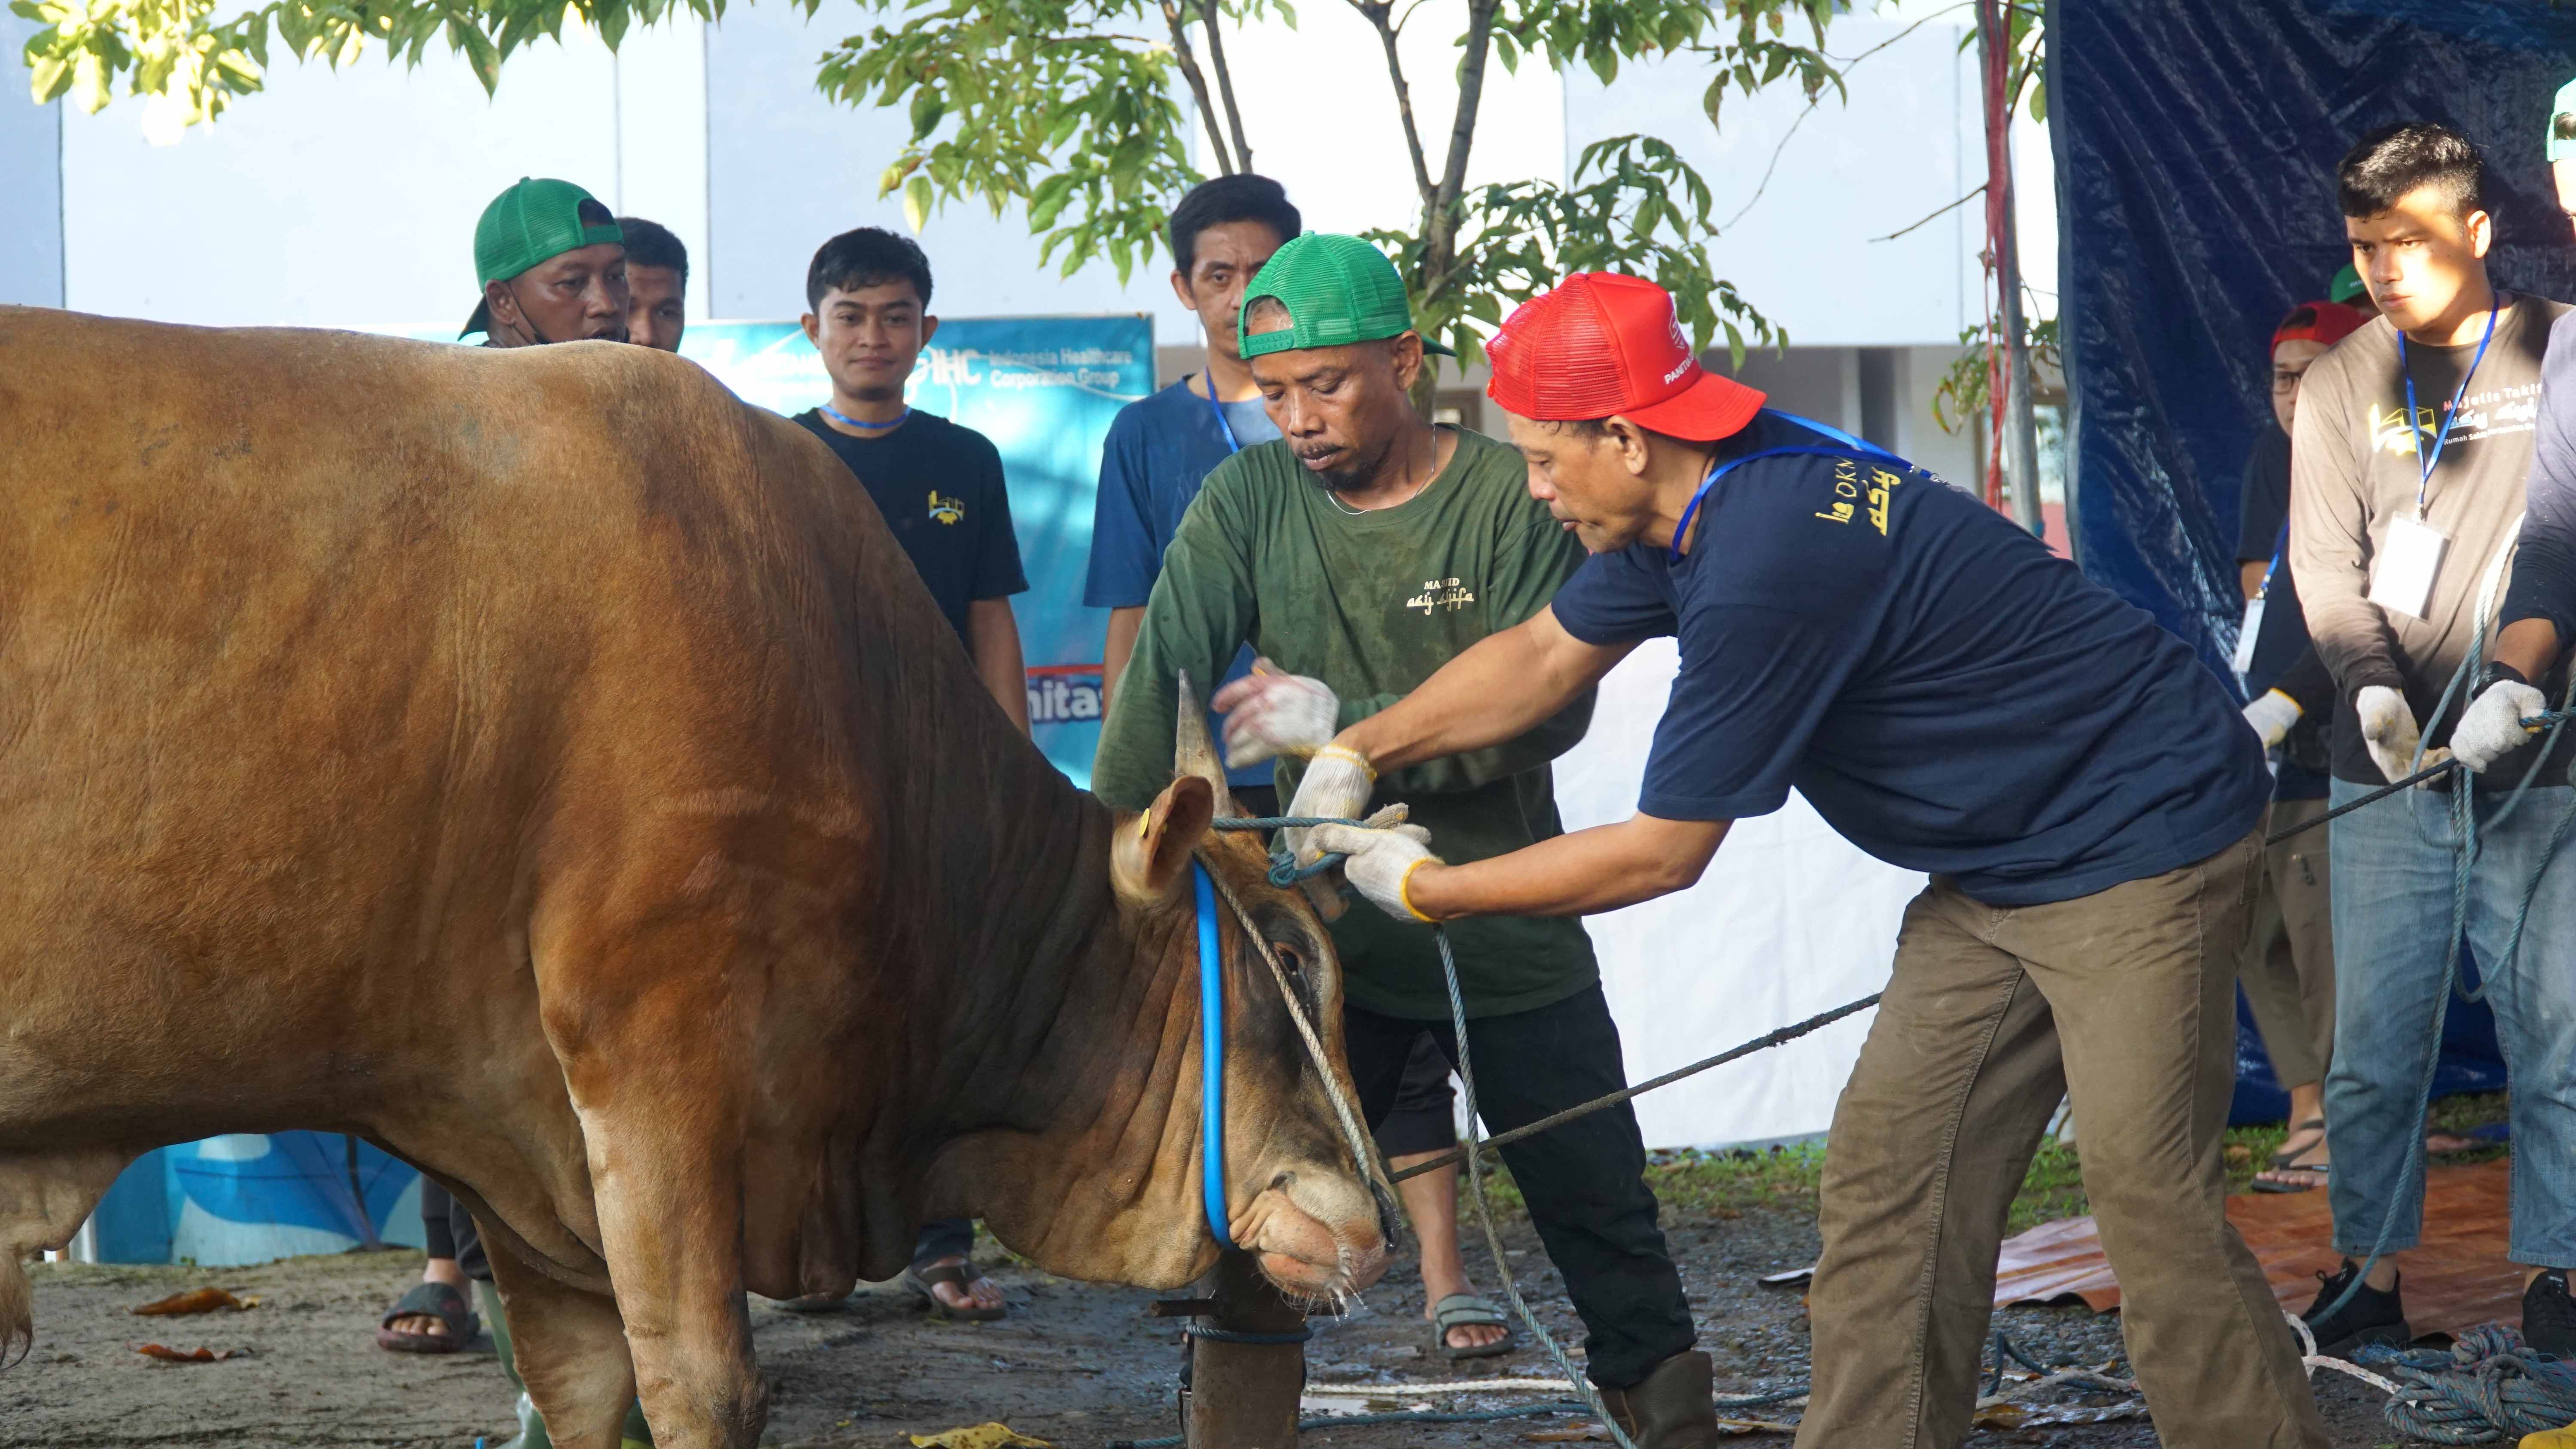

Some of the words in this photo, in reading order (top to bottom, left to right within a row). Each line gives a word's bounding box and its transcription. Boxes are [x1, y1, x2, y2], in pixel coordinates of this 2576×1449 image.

[990, 350, 1058, 366] Indonesia
[1060, 347, 1132, 364] Healthcare
[990, 370, 1075, 390] Corporation
[1078, 367, 1120, 388] Group
[2444, 434, 2467, 445] Rumah
[1424, 578, 1460, 589] MASJID
[1027, 680, 1103, 720] nita
